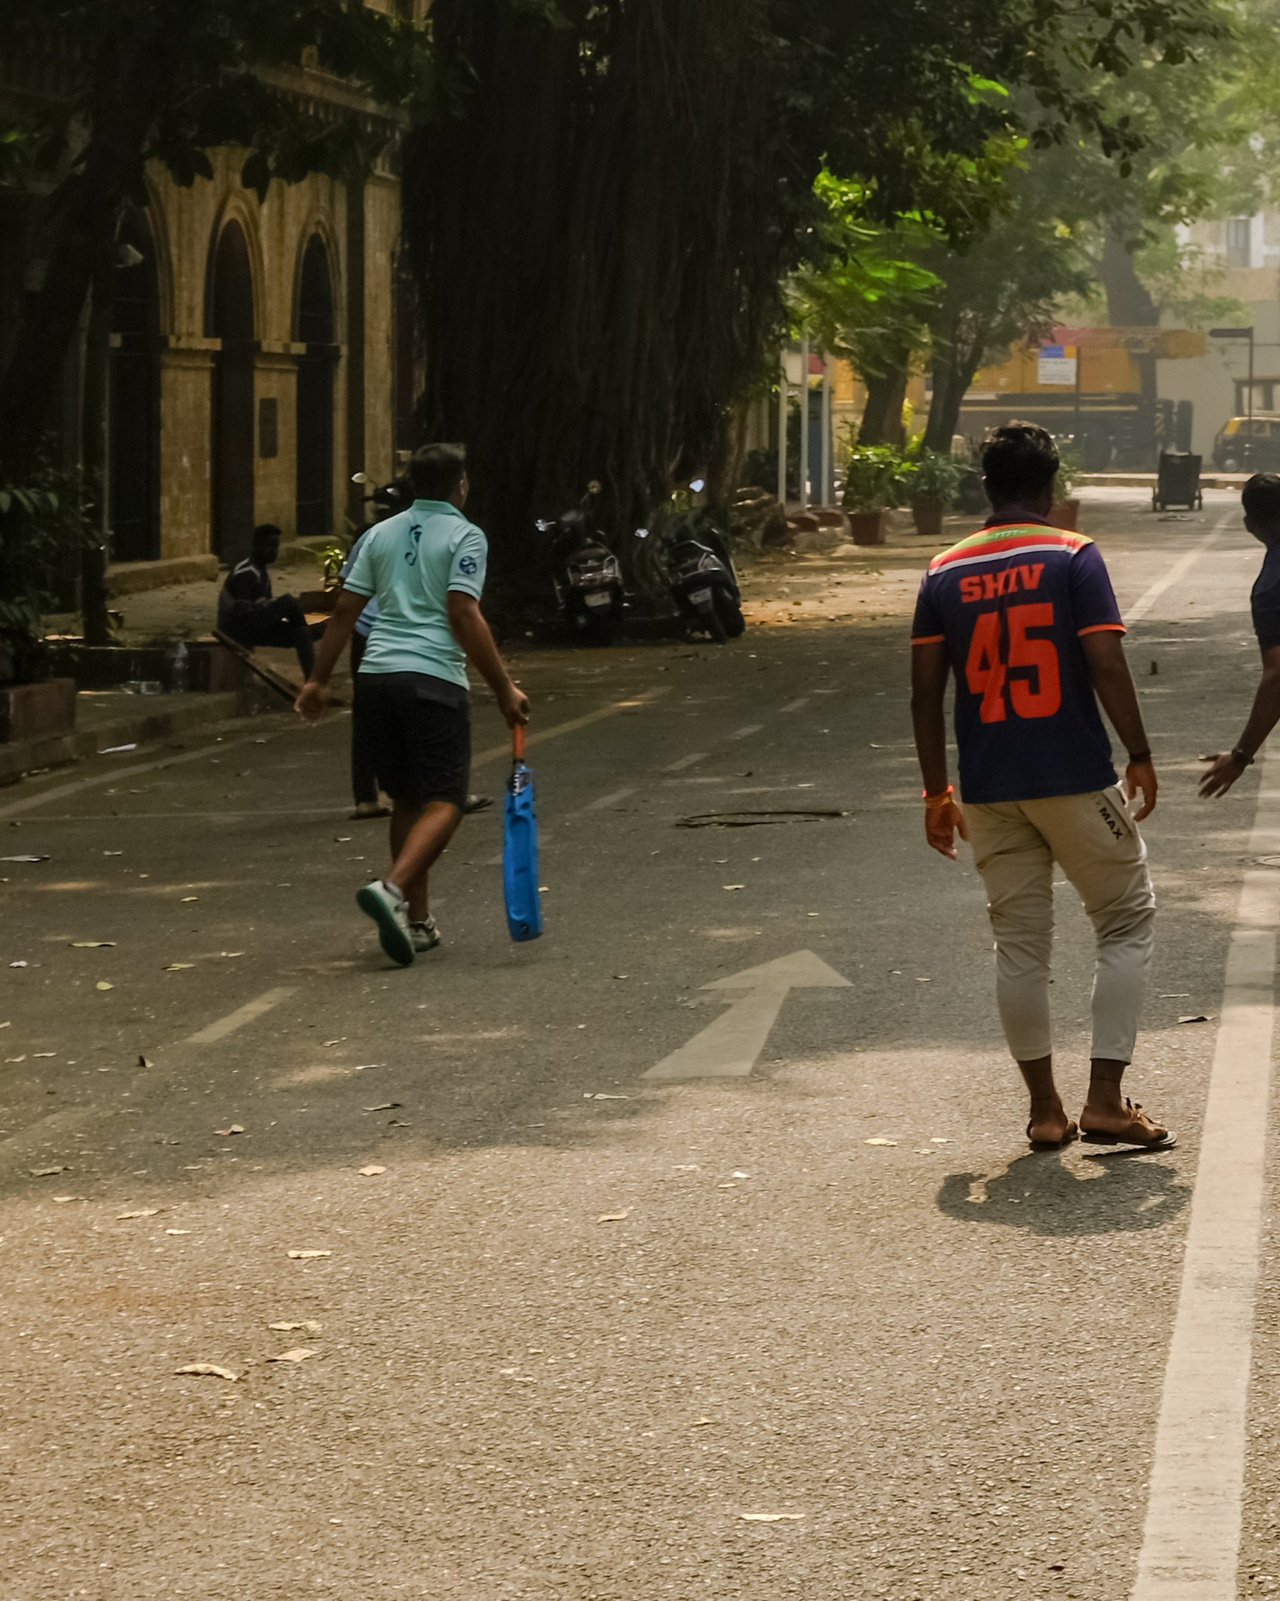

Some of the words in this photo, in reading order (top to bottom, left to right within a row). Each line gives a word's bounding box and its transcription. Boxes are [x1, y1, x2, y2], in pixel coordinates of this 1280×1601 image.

[960, 563, 1045, 603] SHIV
[965, 602, 1062, 723] 45
[1099, 806, 1123, 840] MAX
